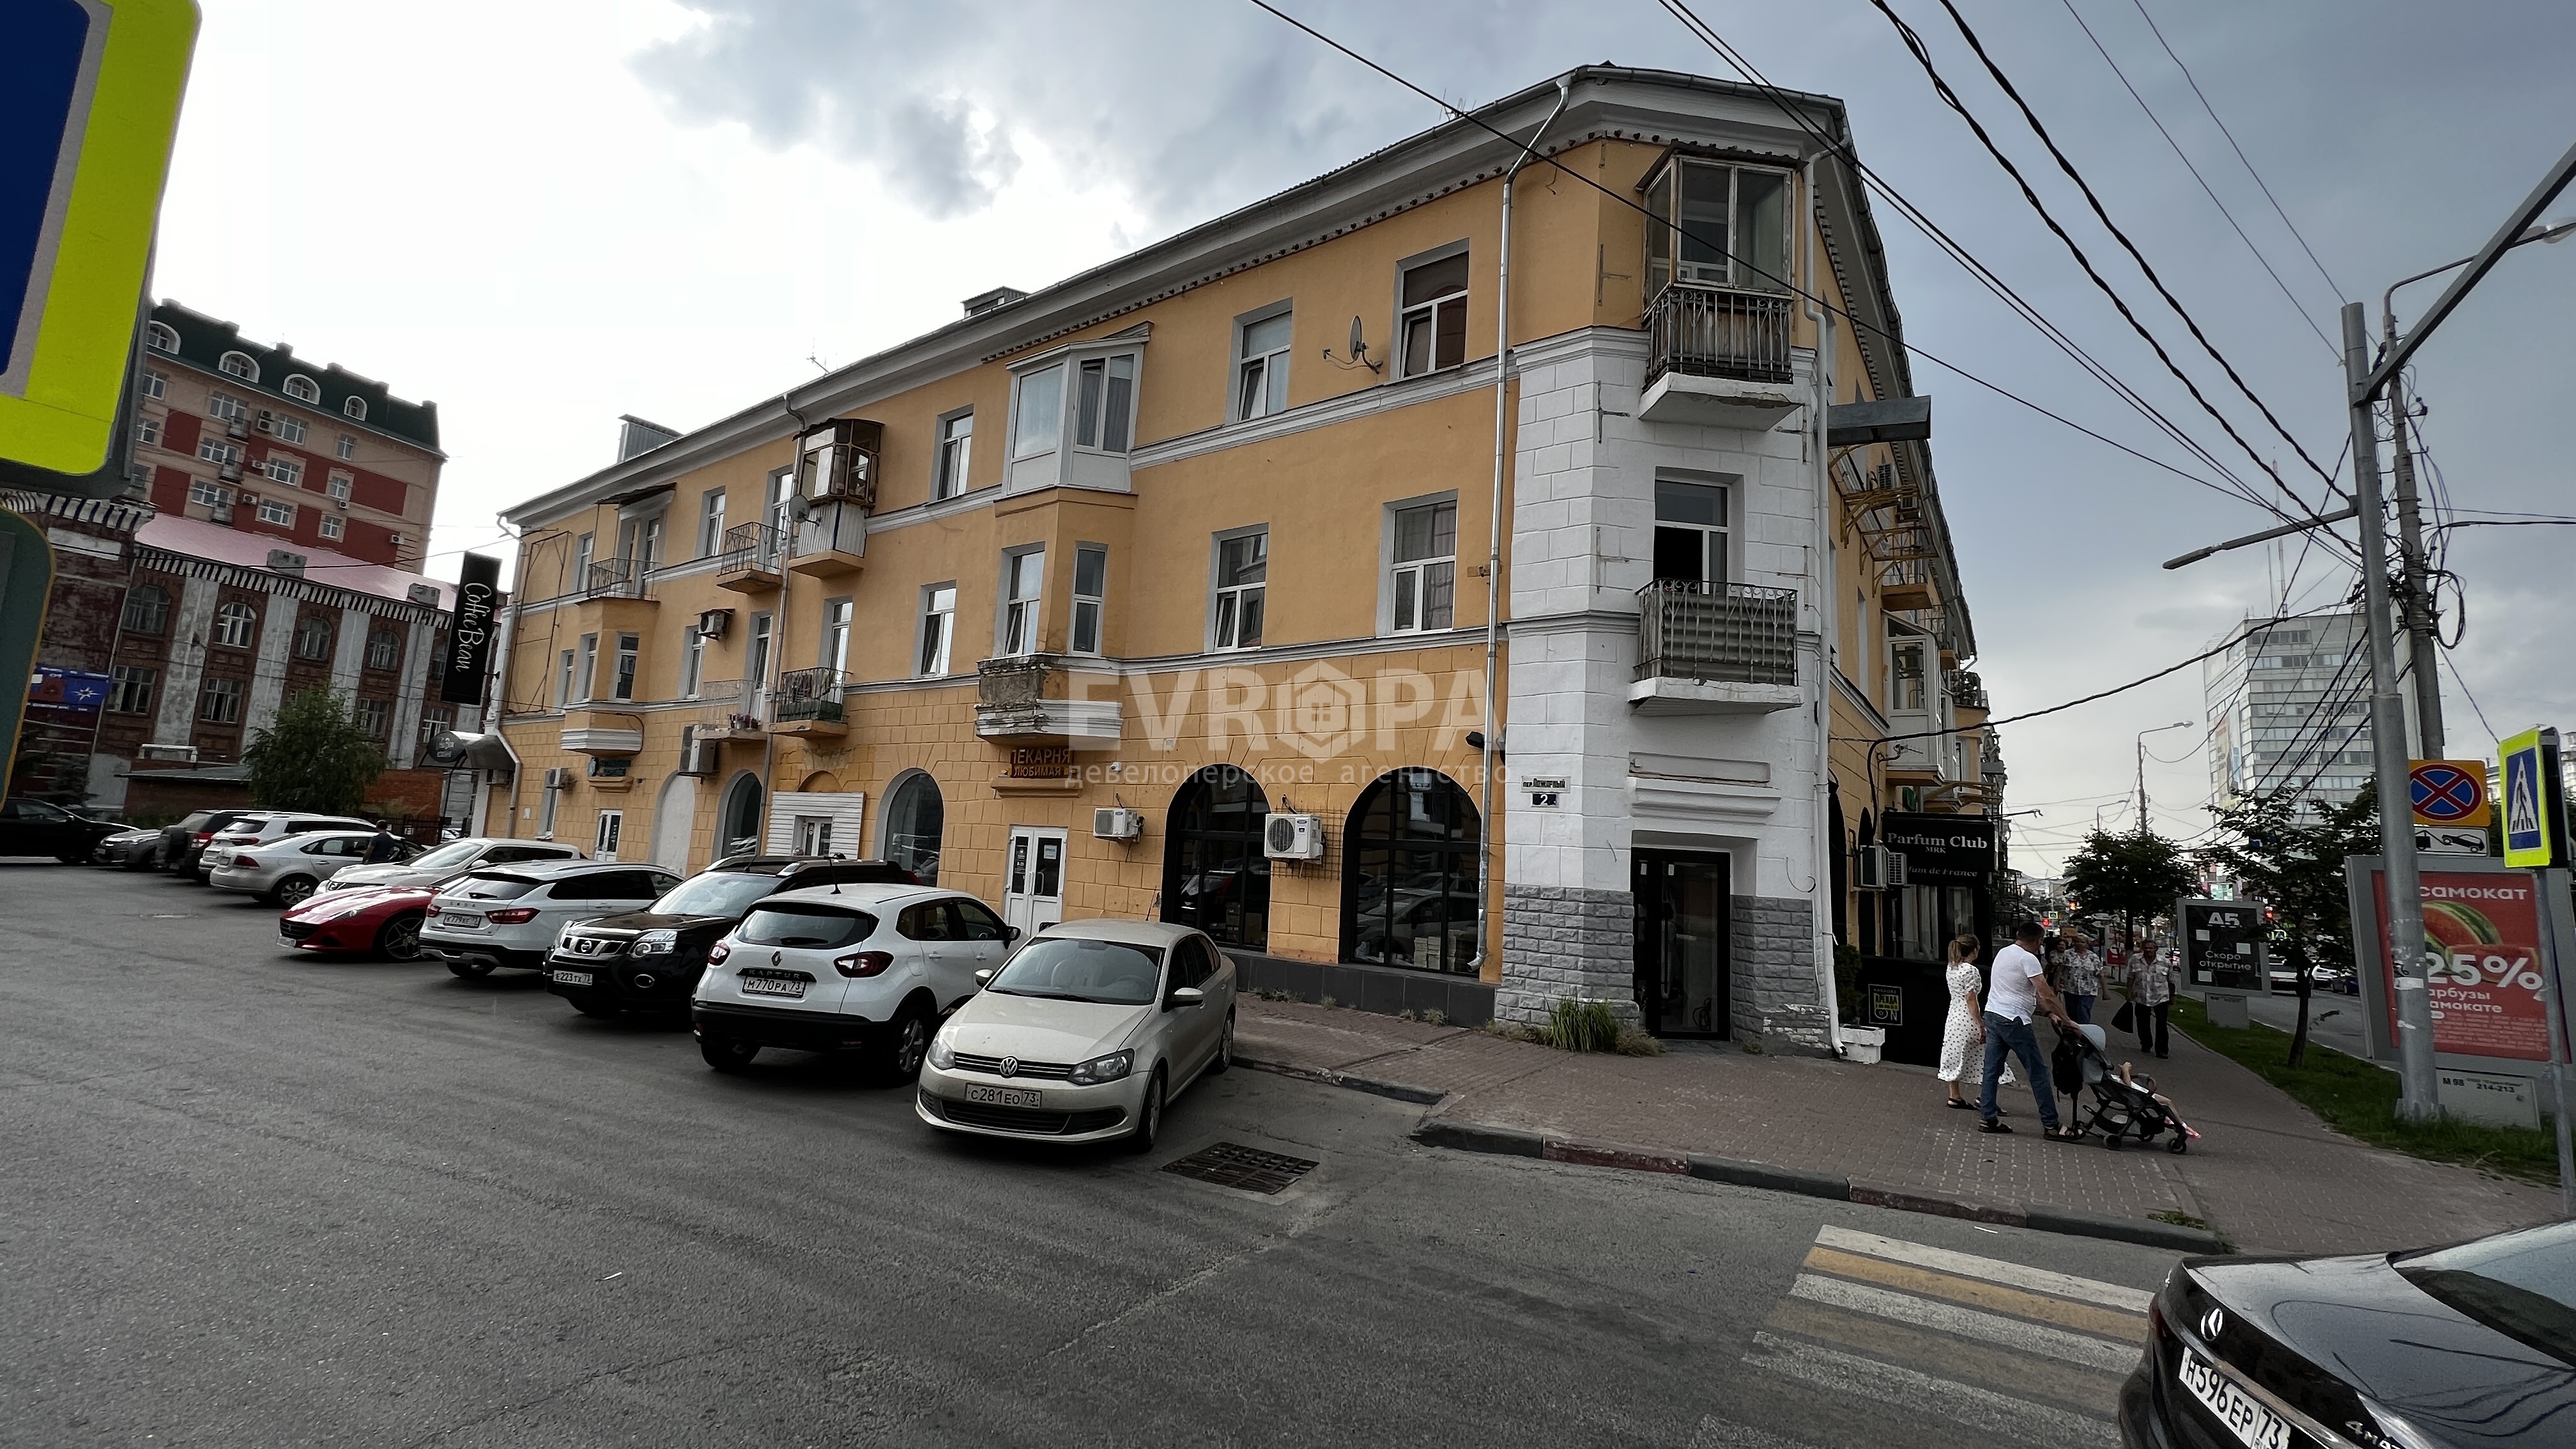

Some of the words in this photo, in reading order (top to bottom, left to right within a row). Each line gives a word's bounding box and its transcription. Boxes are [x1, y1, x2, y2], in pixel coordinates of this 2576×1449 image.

[462, 582, 491, 627] Coffee
[455, 627, 484, 672] Bean
[1013, 766, 1061, 777] ЛЮБИМАЯ
[1540, 793, 1548, 806] 2
[1887, 832, 1945, 847] Parfum
[1949, 836, 1988, 849] Club
[1942, 868, 1978, 877] France
[2419, 885, 2528, 901] самокат
[2205, 950, 2241, 962] Скоро
[2199, 960, 2252, 970] открытие
[749, 969, 800, 979] KAPTUR
[747, 979, 787, 992] М770РА
[789, 981, 801, 992] 73
[2429, 1000, 2503, 1013] амокате
[970, 1088, 1020, 1105] С281ЕО
[1023, 1092, 1036, 1103] 73
[2185, 1358, 2253, 1432] Н596ЕР
[2260, 1407, 2282, 1449] 73
